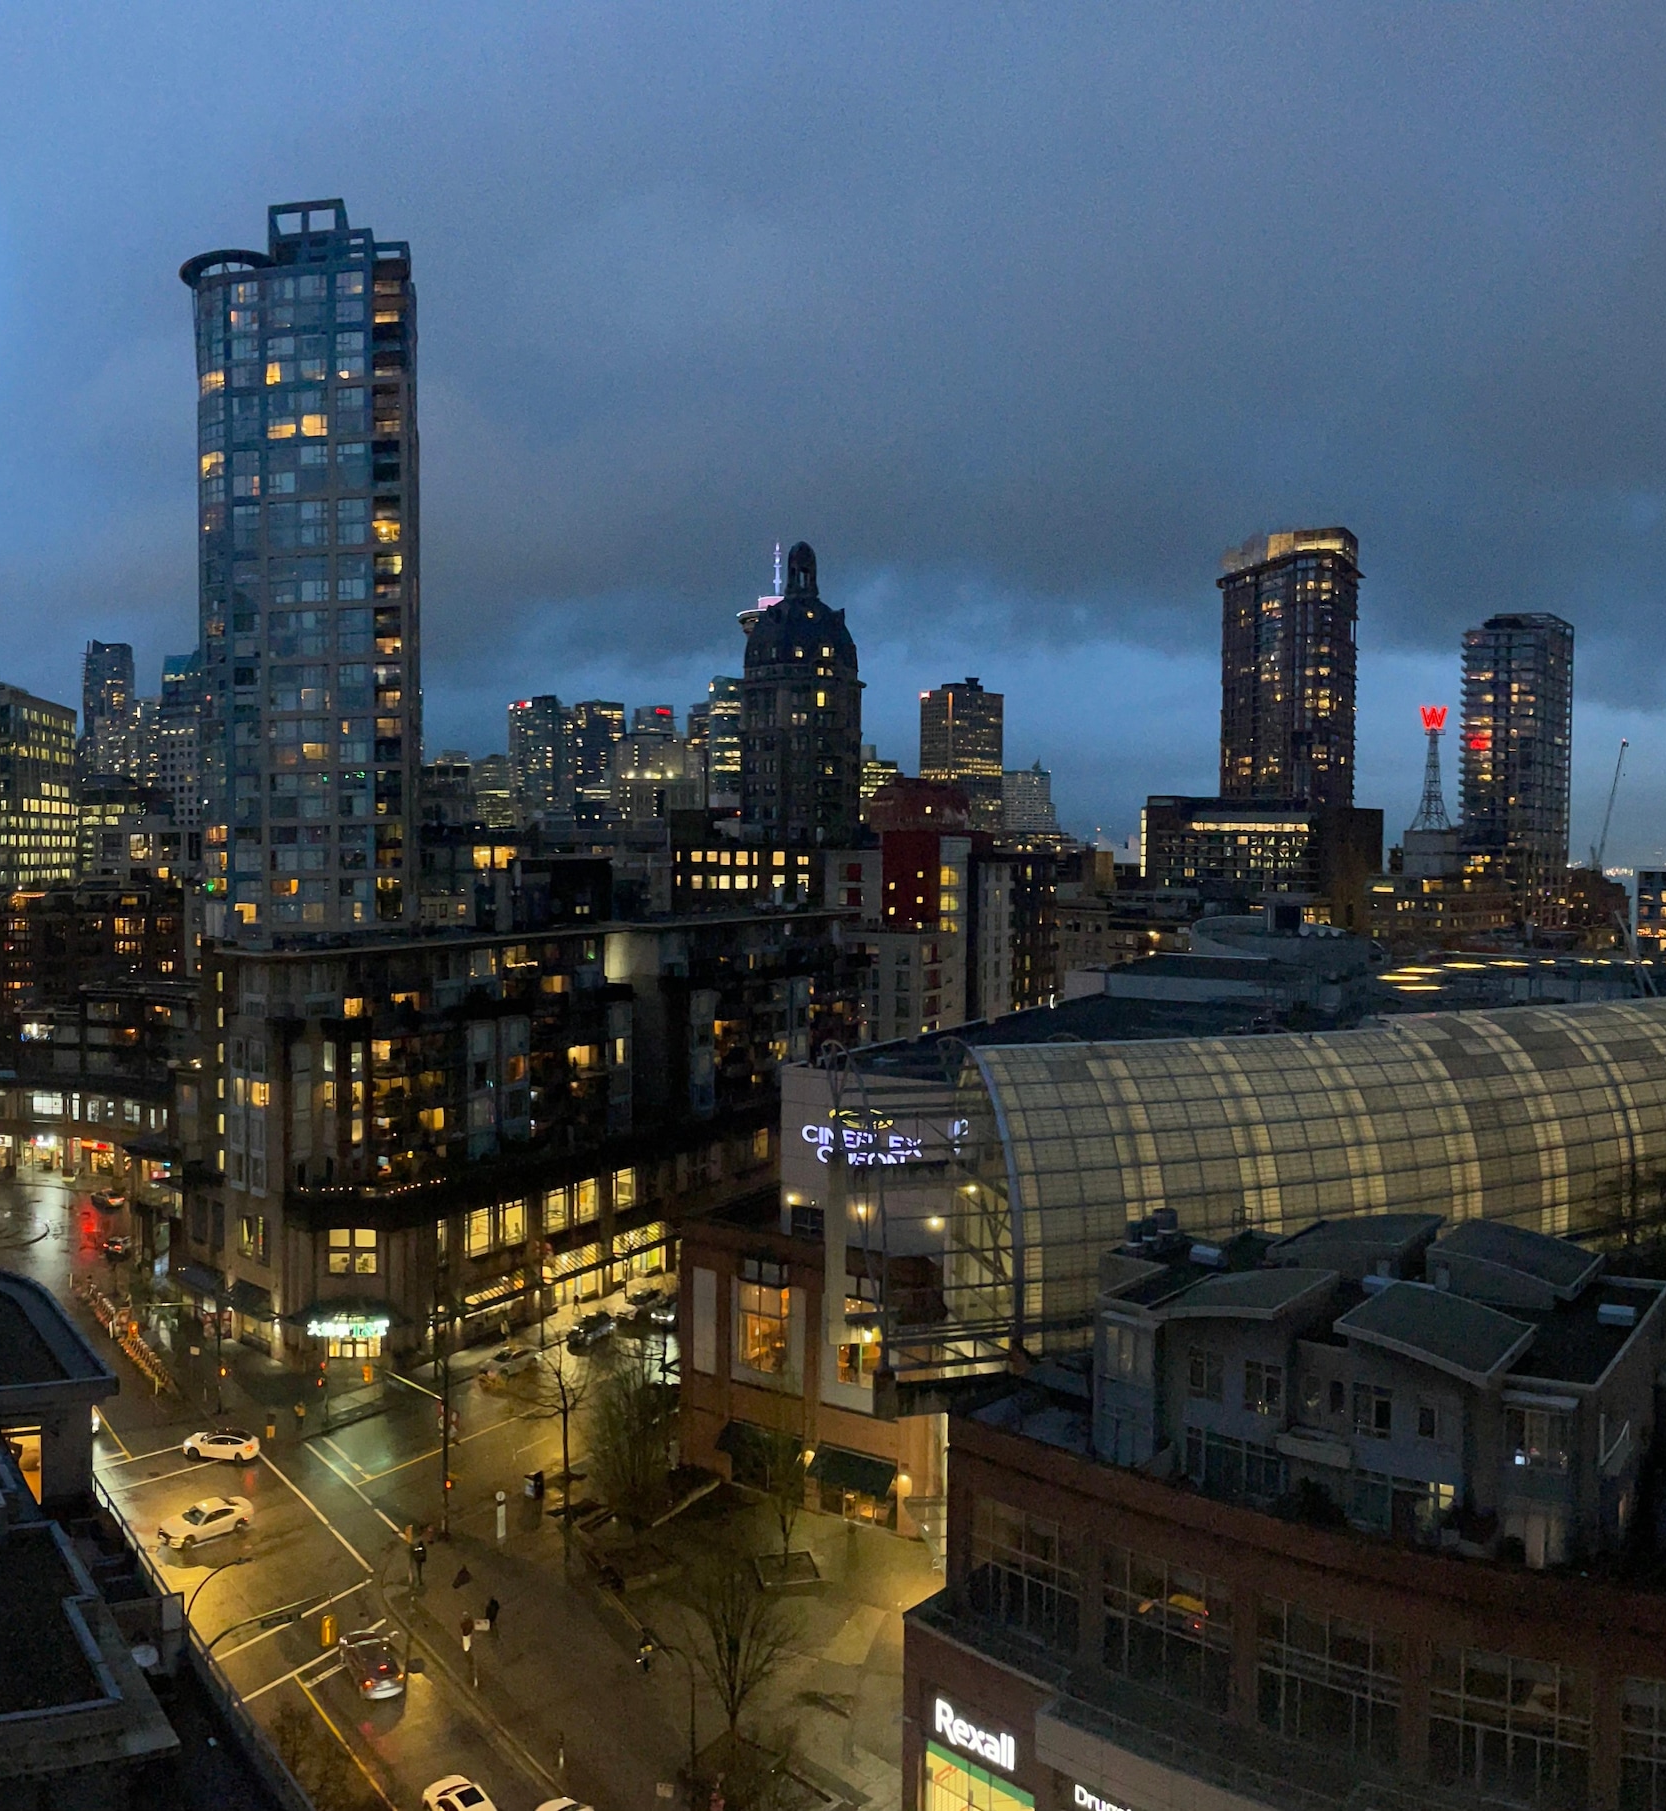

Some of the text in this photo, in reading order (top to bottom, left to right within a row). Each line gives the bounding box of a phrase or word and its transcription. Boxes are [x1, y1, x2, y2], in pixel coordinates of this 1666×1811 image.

[1419, 705, 1449, 731] W
[801, 1124, 923, 1158] CINEPEX
[816, 1145, 907, 1166] OEON
[935, 1698, 1015, 1771] Rexall
